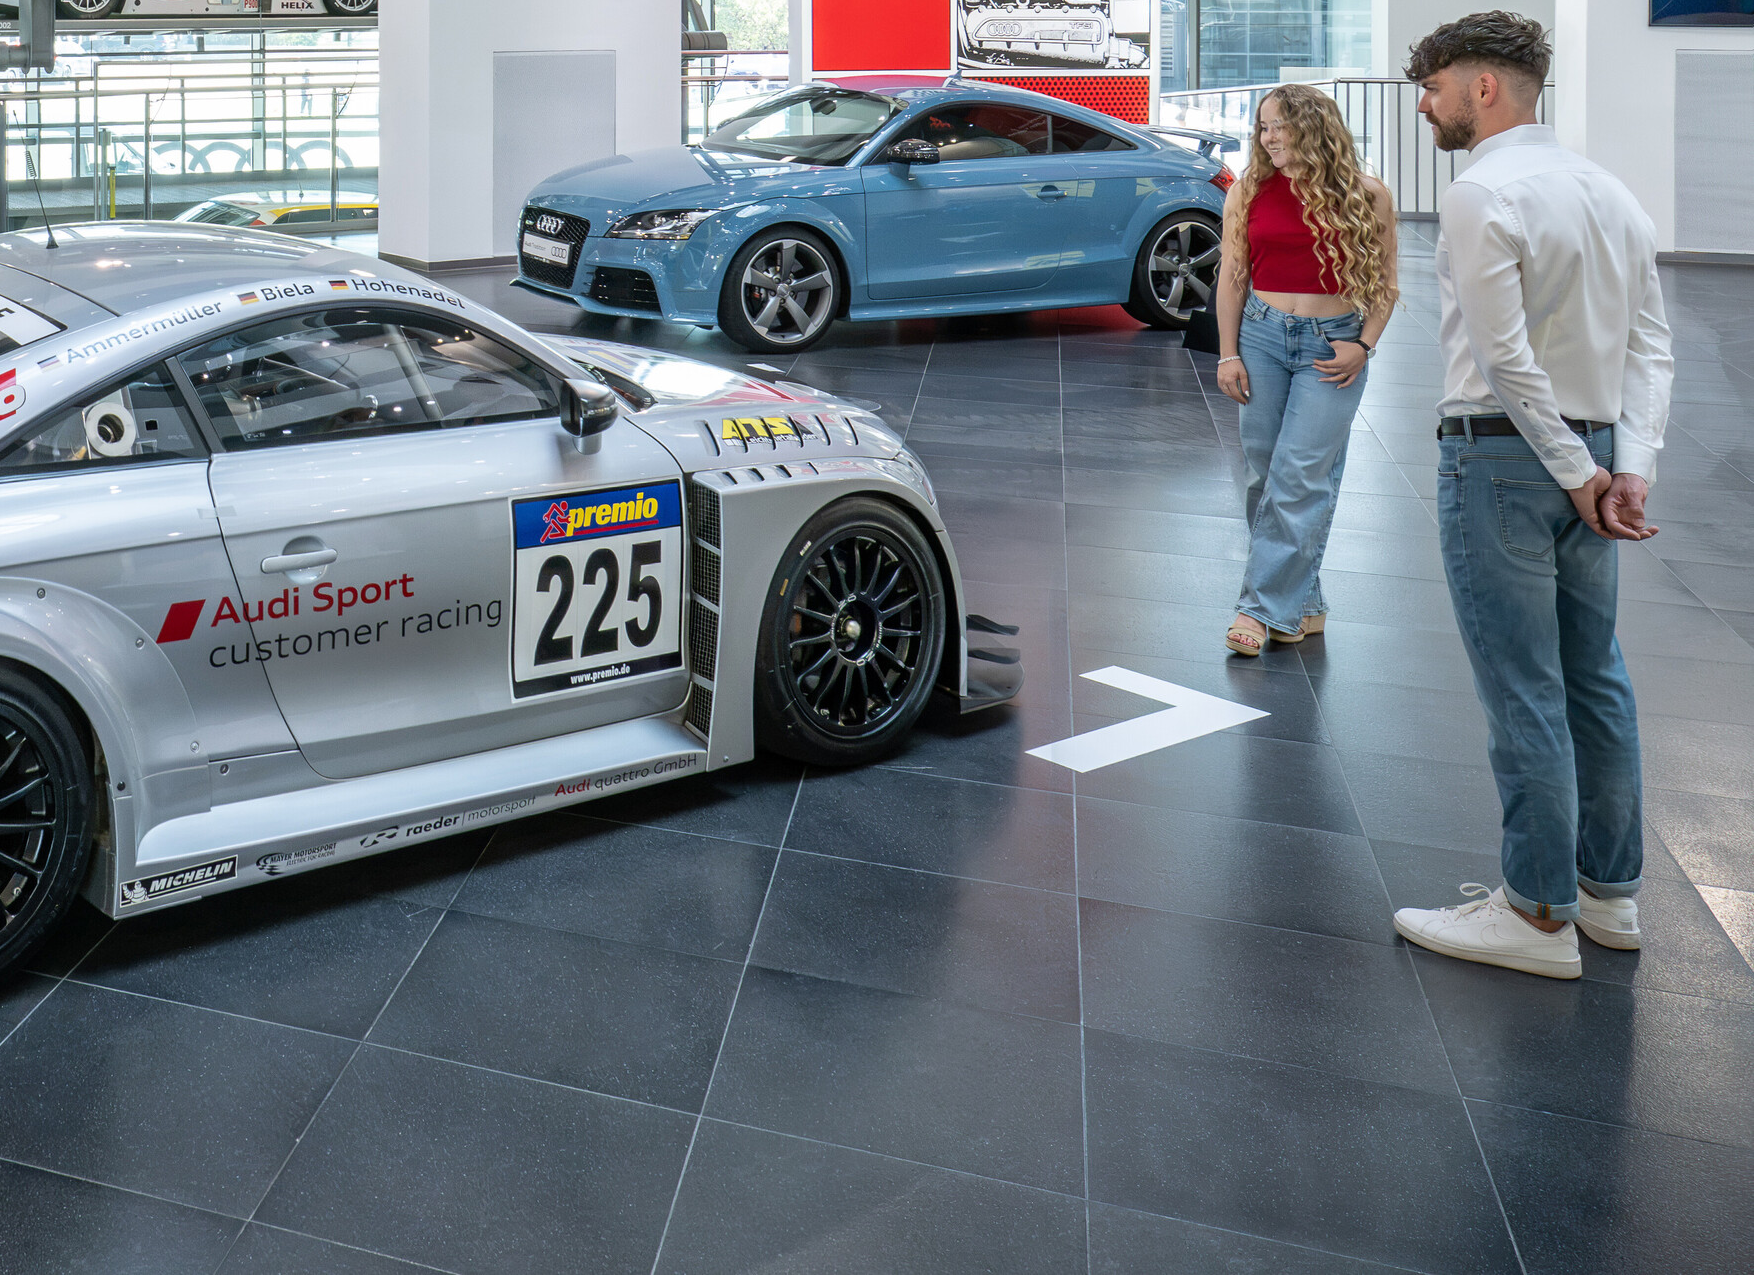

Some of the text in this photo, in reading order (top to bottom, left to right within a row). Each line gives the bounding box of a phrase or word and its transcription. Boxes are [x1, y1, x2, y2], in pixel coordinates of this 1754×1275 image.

[281, 1, 314, 10] HELIX
[1069, 21, 1094, 30] TFSI
[260, 282, 315, 302] Biela
[351, 278, 466, 310] Hohenadel
[66, 300, 222, 365] Ammermüller
[565, 492, 659, 537] premio
[210, 573, 415, 628] Audi Sport
[534, 540, 663, 667] 225
[209, 599, 502, 668] customer racing
[570, 663, 631, 685] www.premio.de
[554, 752, 698, 797] Audi quattro GmbH
[405, 794, 537, 837] raeder motorsport
[270, 842, 337, 864] MAYER MOTORSPORT
[149, 860, 234, 893] MICHELIN
